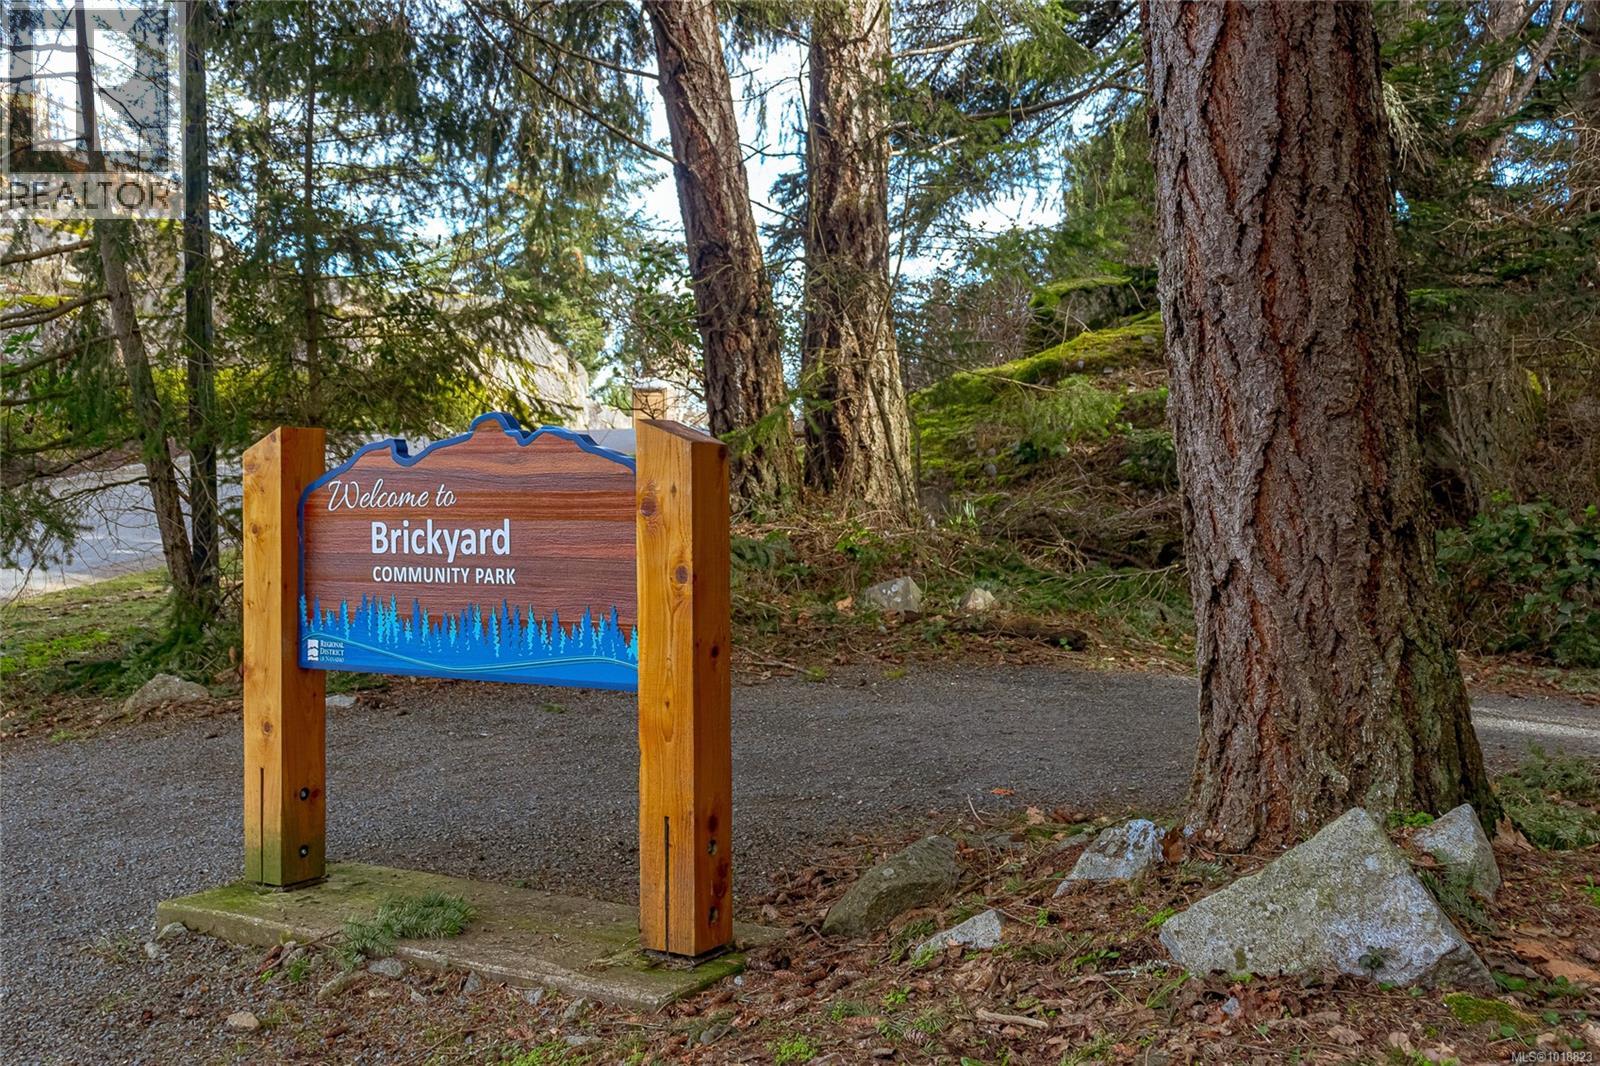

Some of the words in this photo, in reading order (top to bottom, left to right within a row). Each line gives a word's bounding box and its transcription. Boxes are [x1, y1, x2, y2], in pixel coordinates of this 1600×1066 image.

[327, 478, 430, 512] Welcome
[435, 483, 457, 507] to
[370, 518, 512, 563] Brickyard
[372, 565, 470, 584] COMMUNITY
[474, 567, 517, 585] PARK
